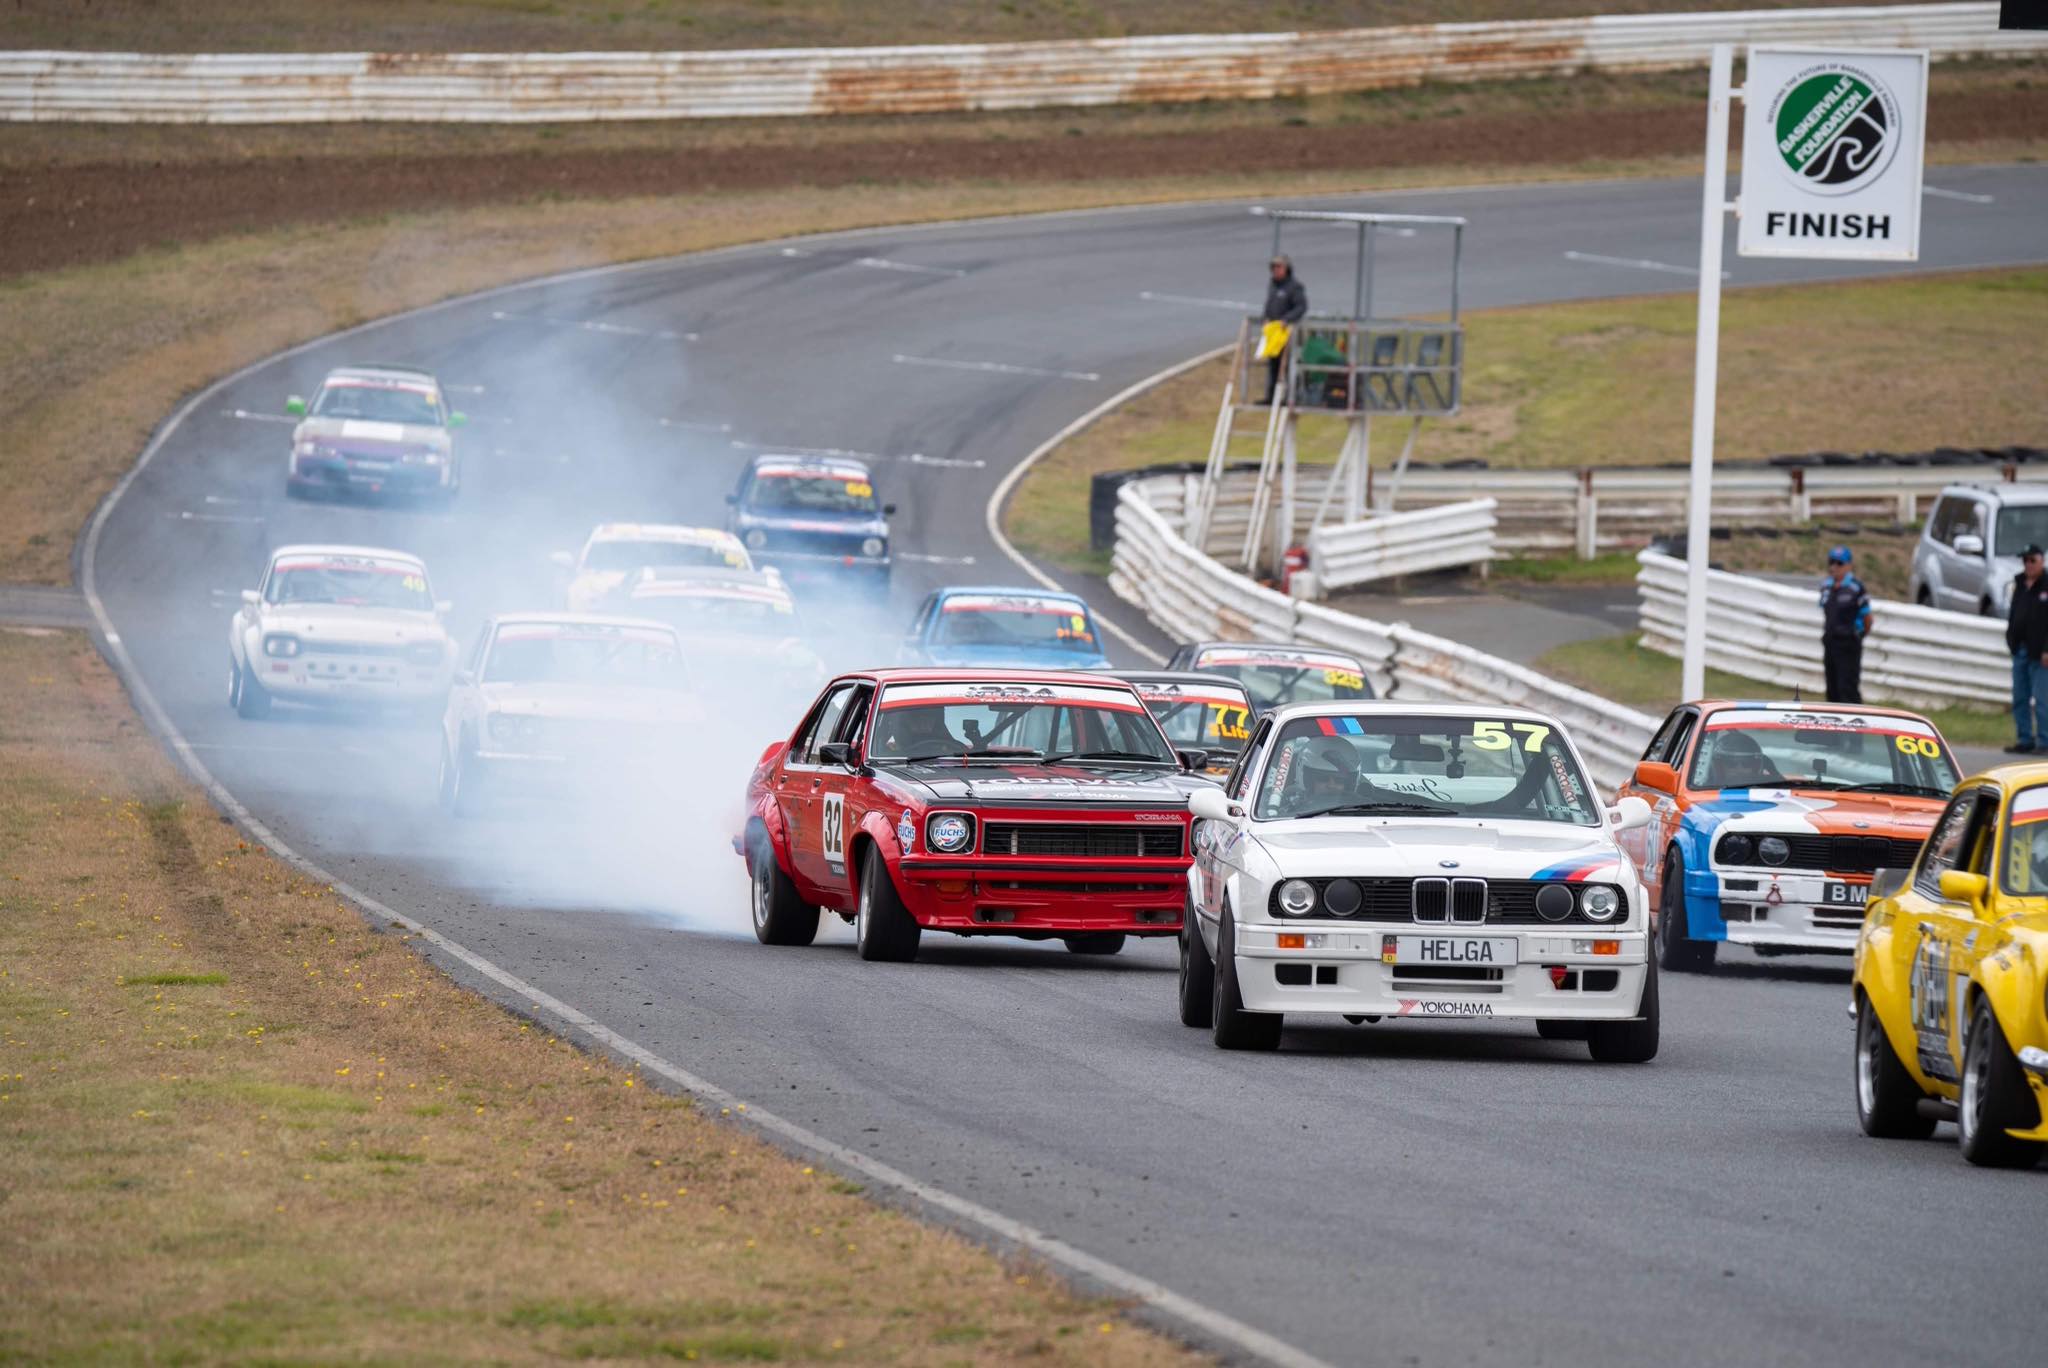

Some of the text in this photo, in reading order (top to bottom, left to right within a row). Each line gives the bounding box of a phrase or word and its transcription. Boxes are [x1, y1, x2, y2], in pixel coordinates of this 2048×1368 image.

[1779, 76, 1853, 153] BASKERVILLE
[1795, 90, 1864, 163] FOUNDATION
[1767, 212, 1890, 239] FINISH
[1208, 703, 1249, 728] 77
[1472, 721, 1550, 752] 57
[1895, 734, 1940, 759] 60
[825, 799, 842, 853] 32
[899, 824, 915, 840] FUCHS
[934, 828, 965, 838] FUCHS
[1420, 939, 1494, 962] HELGA
[1420, 1001, 1494, 1015] YOKOHAMA
